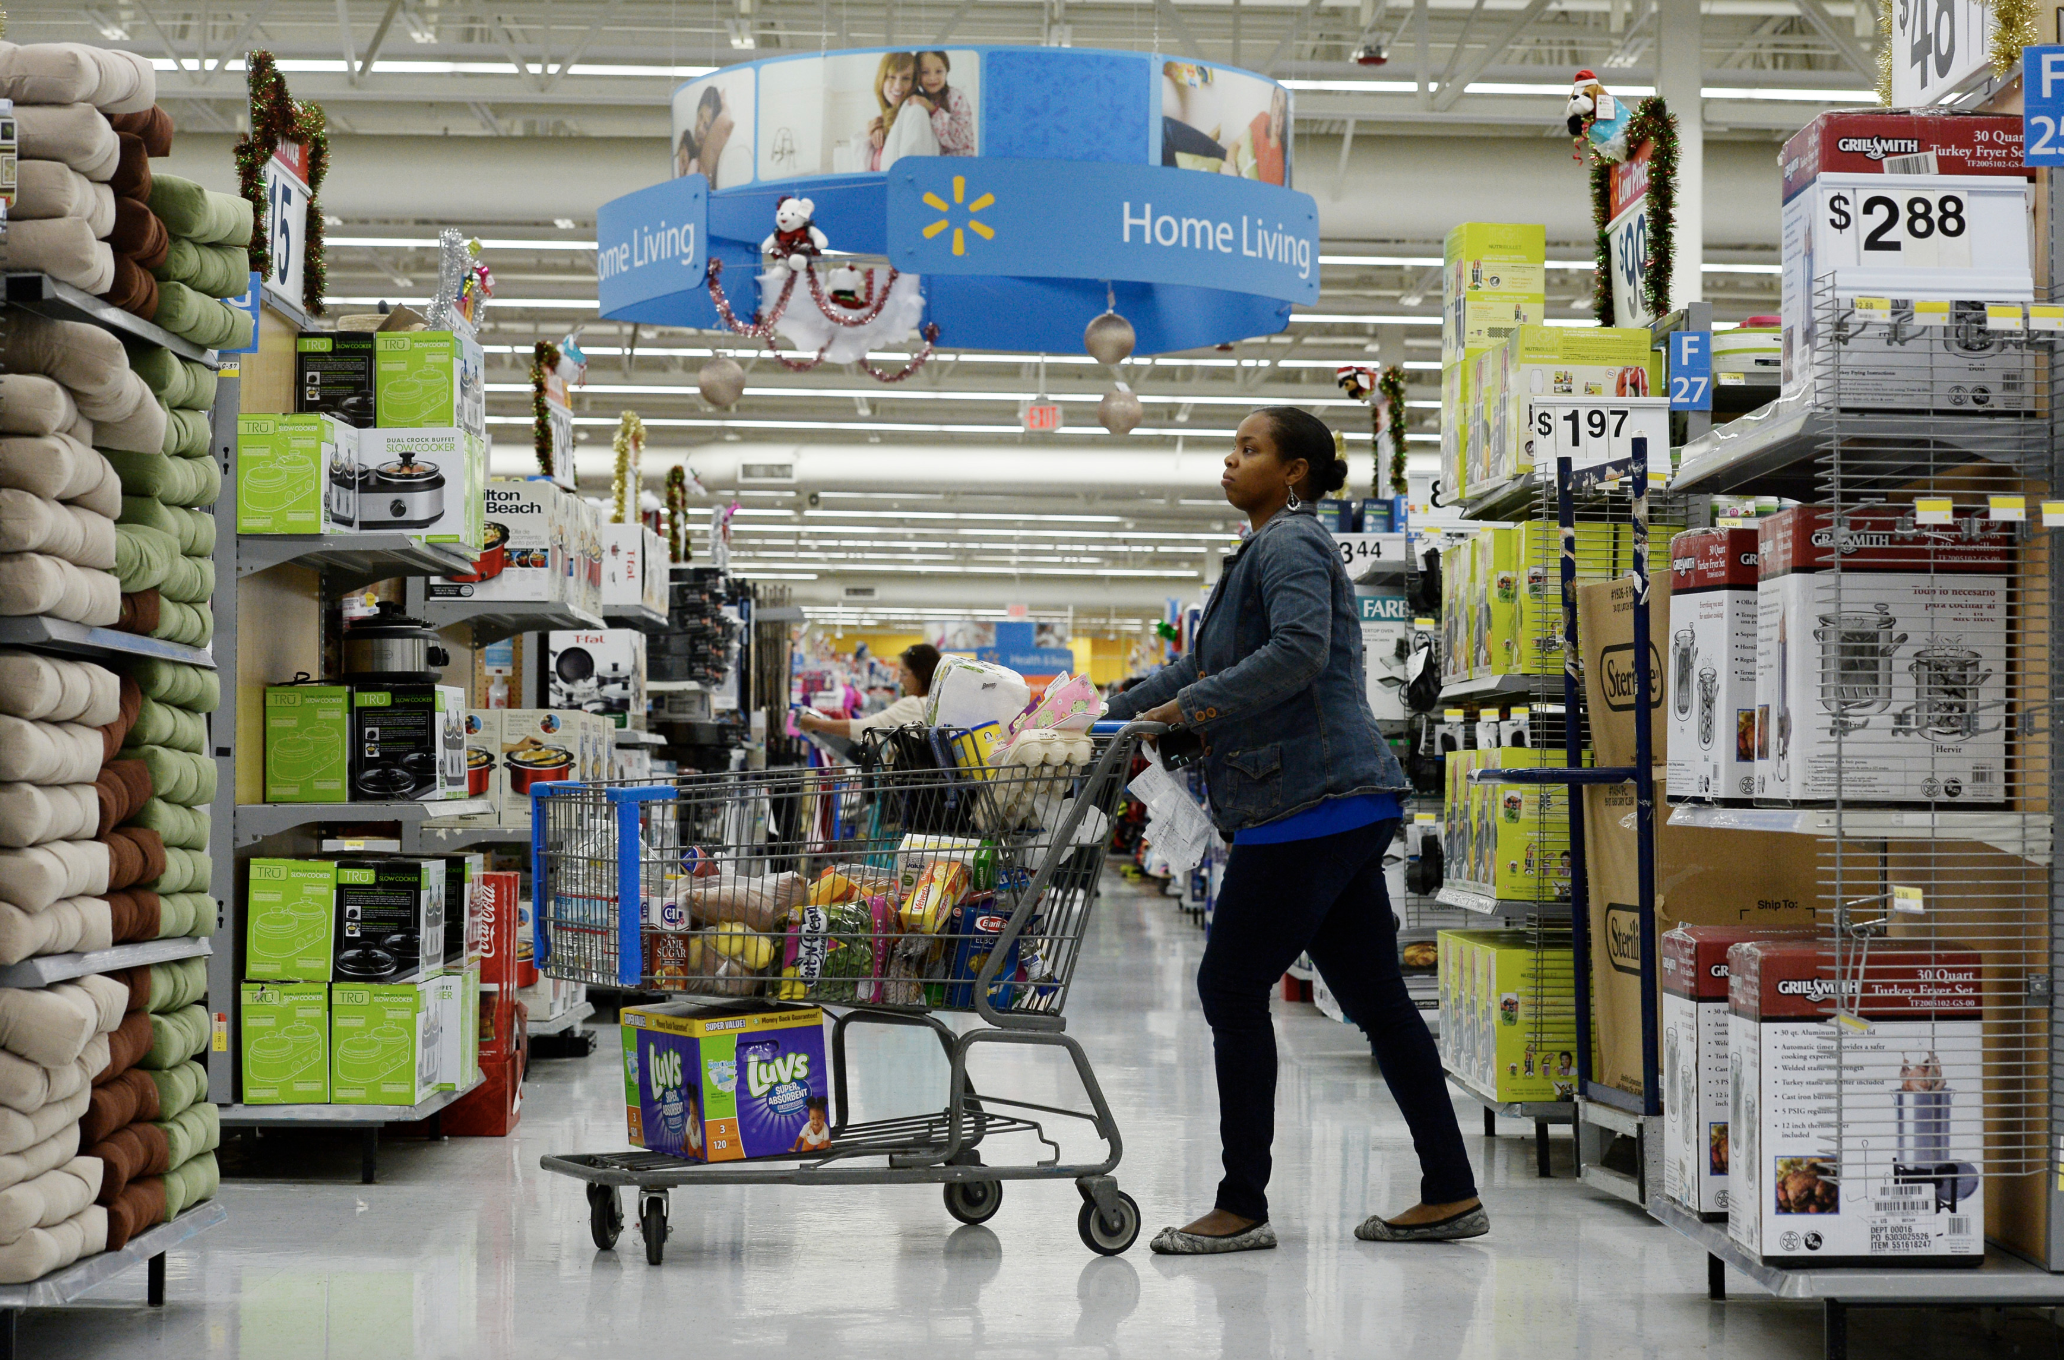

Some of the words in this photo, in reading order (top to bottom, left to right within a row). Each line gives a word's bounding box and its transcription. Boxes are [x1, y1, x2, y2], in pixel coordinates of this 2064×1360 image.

[1973, 130, 1989, 142] 30
[1992, 130, 2024, 145] Quar
[2029, 115, 2064, 155] 2
[1837, 136, 1919, 158] GRILLSMITH
[1929, 144, 1972, 160] Turkey
[1975, 145, 2007, 160] Fryer
[2010, 145, 2024, 158] Se
[1618, 174, 1632, 206] Low
[269, 174, 292, 286] 15
[1123, 201, 1233, 254] Home
[1242, 214, 1311, 280] Living
[598, 242, 630, 281] ome
[633, 220, 695, 268] Living
[1681, 336, 1700, 366] F
[1672, 376, 1709, 403] 27
[1029, 406, 1058, 429] EXIT
[385, 443, 414, 453] SLOW
[414, 443, 455, 452] COOKER
[486, 501, 542, 514] Beach
[626, 550, 636, 580] T-fal
[573, 634, 606, 644] T-fal
[1606, 659, 1658, 697] Sterie
[1935, 744, 1963, 755] Hervir
[1757, 900, 1781, 911] Ship
[1782, 899, 1799, 909] To:
[975, 937, 995, 945] ELBO
[1611, 916, 1640, 964] Sterili
[656, 948, 687, 958] SUGAR
[1916, 969, 1933, 980] 30
[1935, 968, 1974, 983] Quart
[1871, 984, 1915, 1000] Turkey
[1954, 983, 1974, 995] Set
[705, 1020, 725, 1032] SUPER
[725, 1019, 746, 1030] VALUE!
[1870, 1042, 1886, 1050] safer
[1781, 1053, 1808, 1061] cooking
[649, 1041, 682, 1102] Luvs
[747, 1052, 810, 1099] Luvs
[775, 1081, 797, 1095] SUPER
[1782, 1079, 1804, 1087] Turkey
[665, 1089, 680, 1103] SUPER
[768, 1088, 808, 1106] ABSORBENT
[662, 1101, 684, 1117] ABSORBENT
[632, 1112, 637, 1122] 3
[719, 1124, 726, 1134] 3
[713, 1140, 727, 1150] 120
[1870, 1226, 1888, 1234] DEPT
[1890, 1225, 1913, 1233] 00016
[1871, 1233, 1881, 1241] PO
[1885, 1232, 1930, 1241] 6303025526
[1871, 1241, 1889, 1249] ITEM
[1892, 1240, 1932, 1249] 551618247
